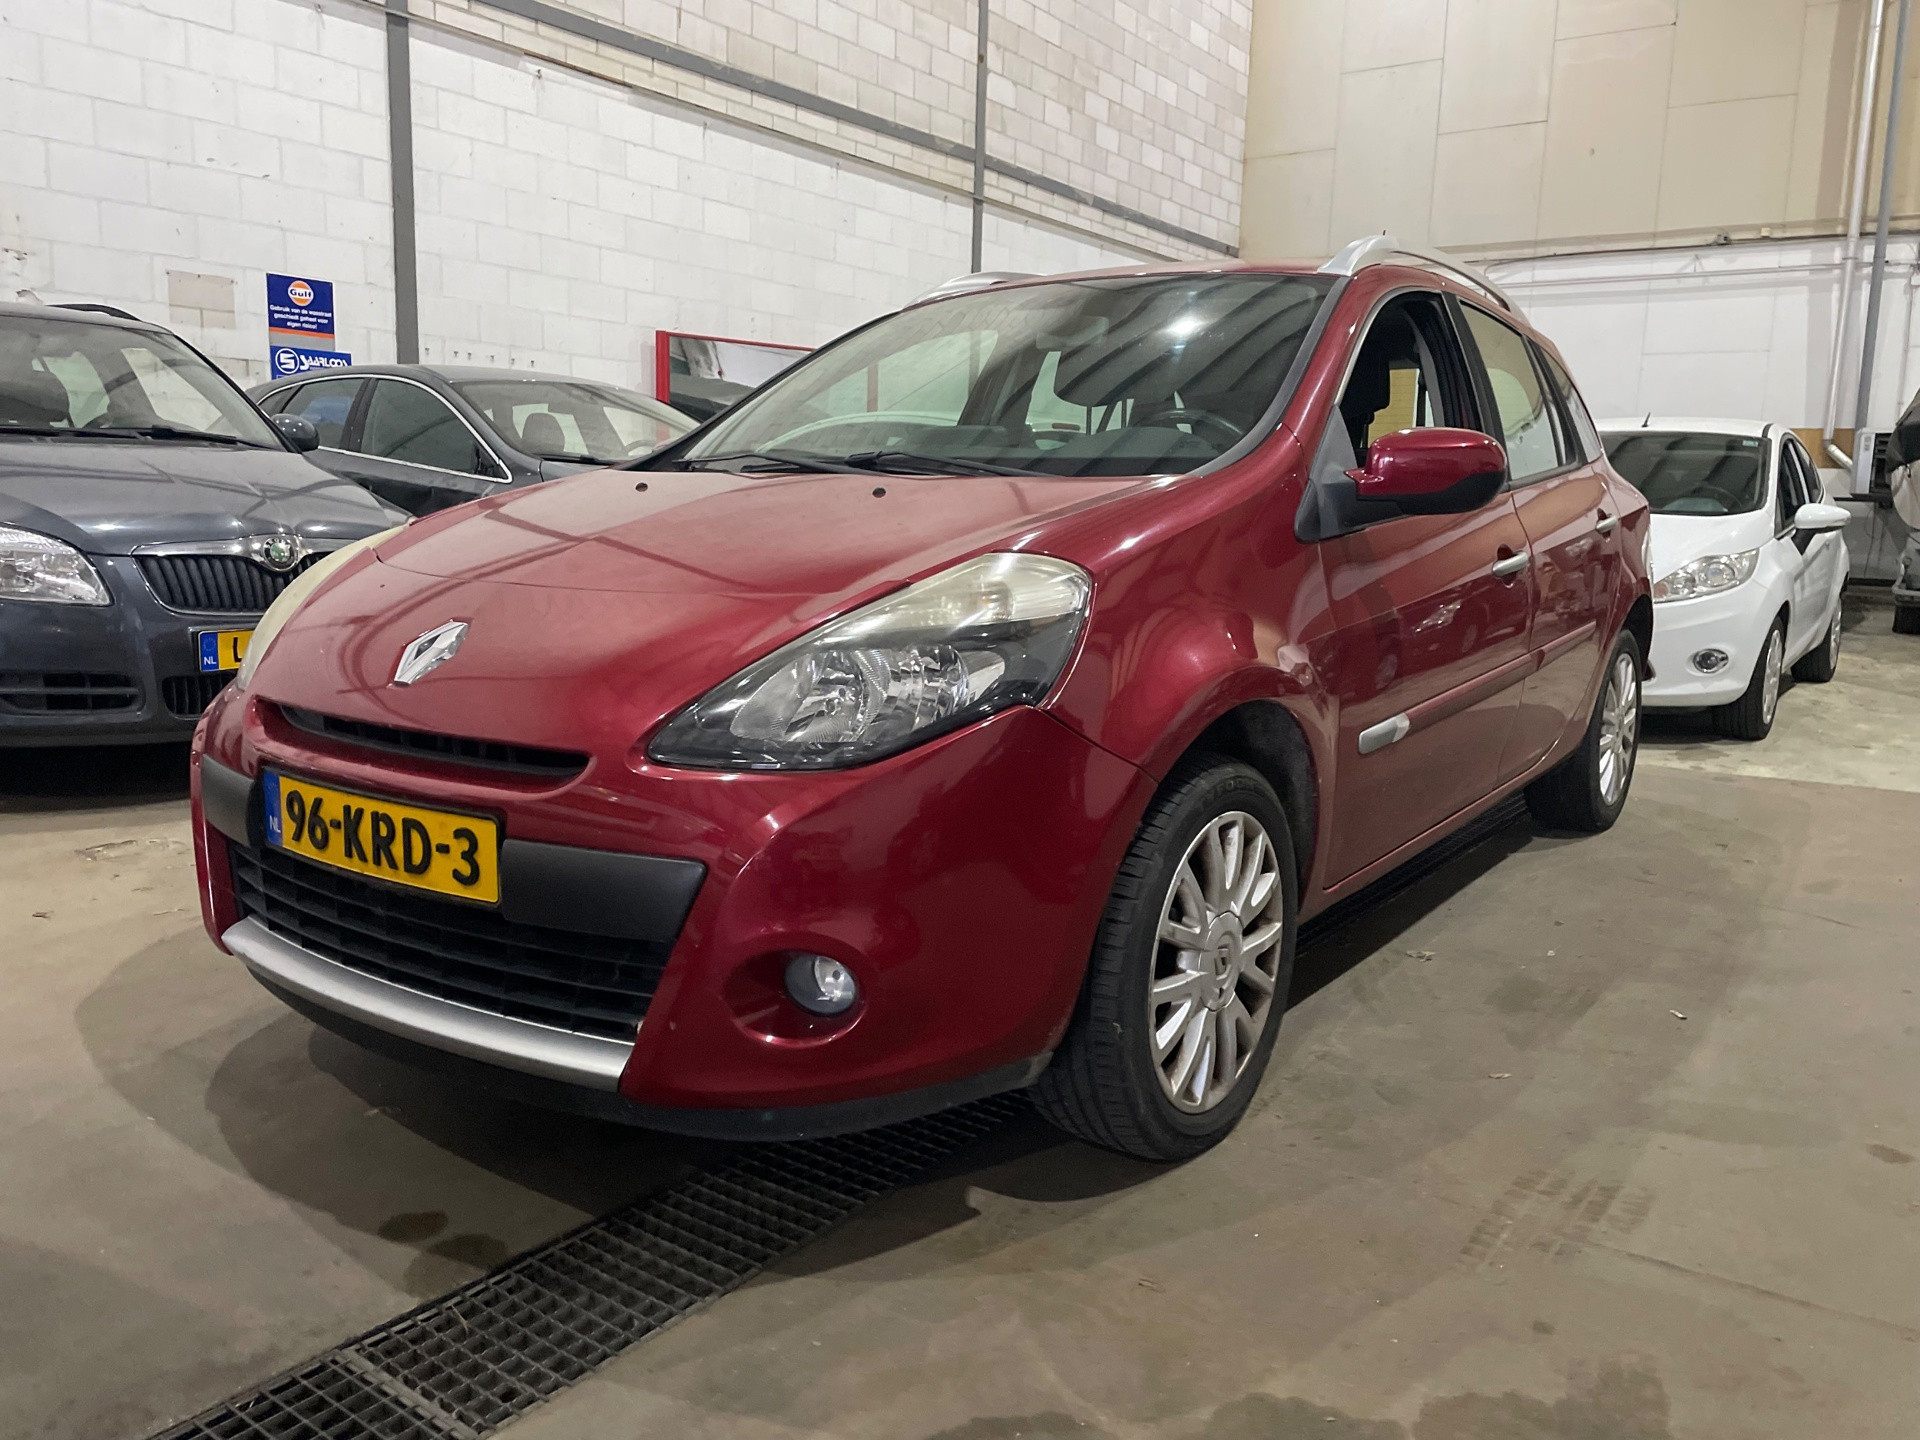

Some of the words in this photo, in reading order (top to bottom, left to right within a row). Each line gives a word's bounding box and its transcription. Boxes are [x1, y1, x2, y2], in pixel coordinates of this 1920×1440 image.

[290, 288, 311, 298] Gulf
[270, 304, 290, 312] Gebruik
[203, 656, 217, 665] NL
[269, 815, 281, 833] NL
[286, 790, 481, 886] 96-KRD-3
